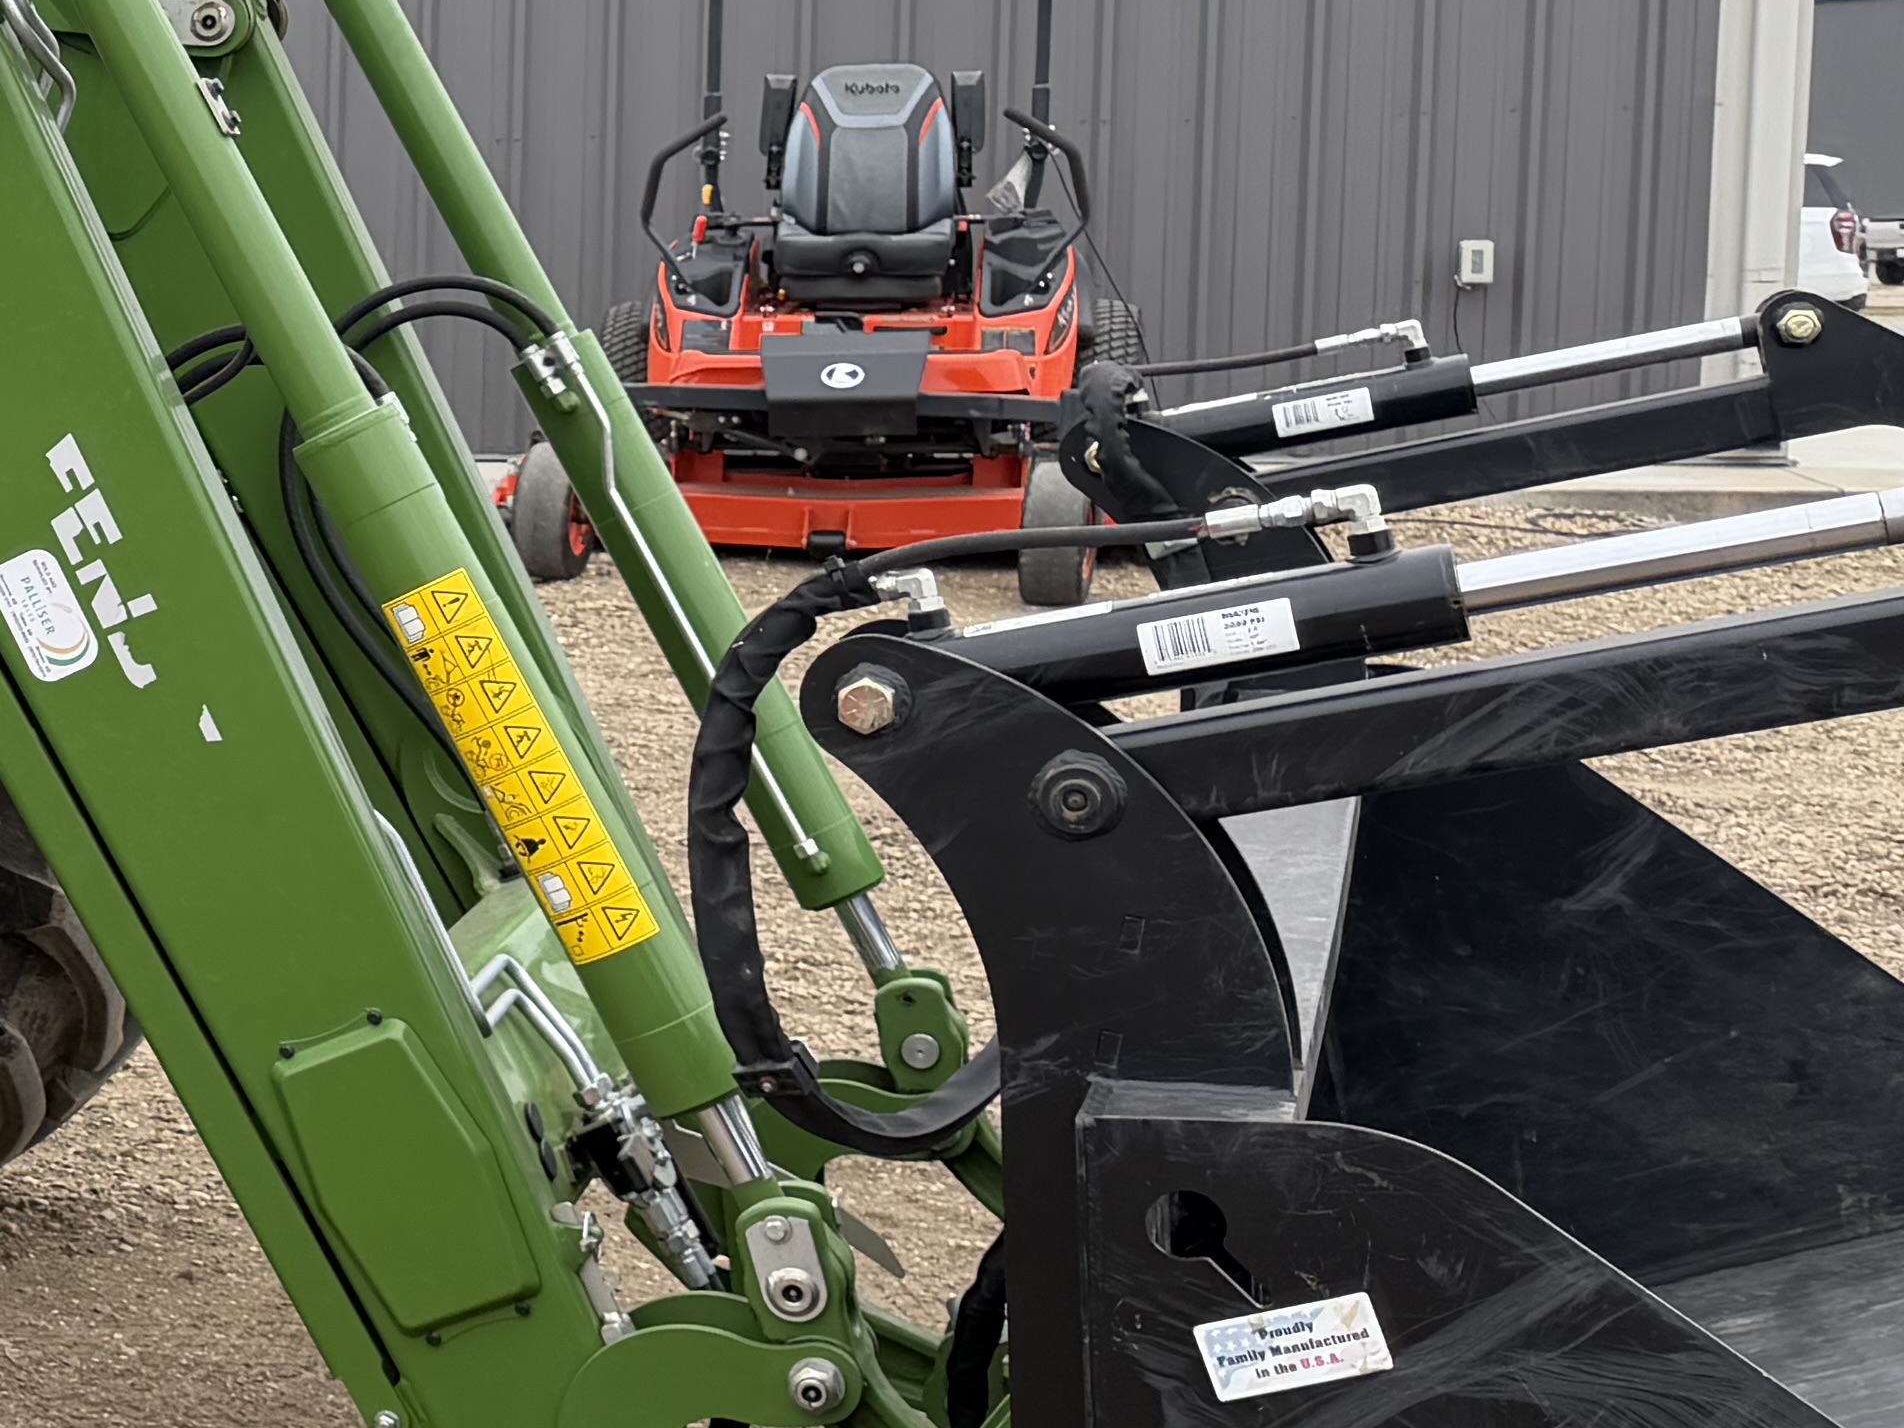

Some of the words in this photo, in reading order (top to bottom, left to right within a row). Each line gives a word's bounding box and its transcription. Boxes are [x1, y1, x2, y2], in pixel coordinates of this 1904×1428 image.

[844, 81, 900, 96] Kubota
[1258, 1320, 1314, 1341] Proudly
[1216, 1348, 1267, 1368] Family
[1270, 1327, 1370, 1358] Manufactured
[1255, 1366, 1270, 1379] in
[1274, 1361, 1298, 1376] the
[1300, 1352, 1344, 1371] U.S.A.
